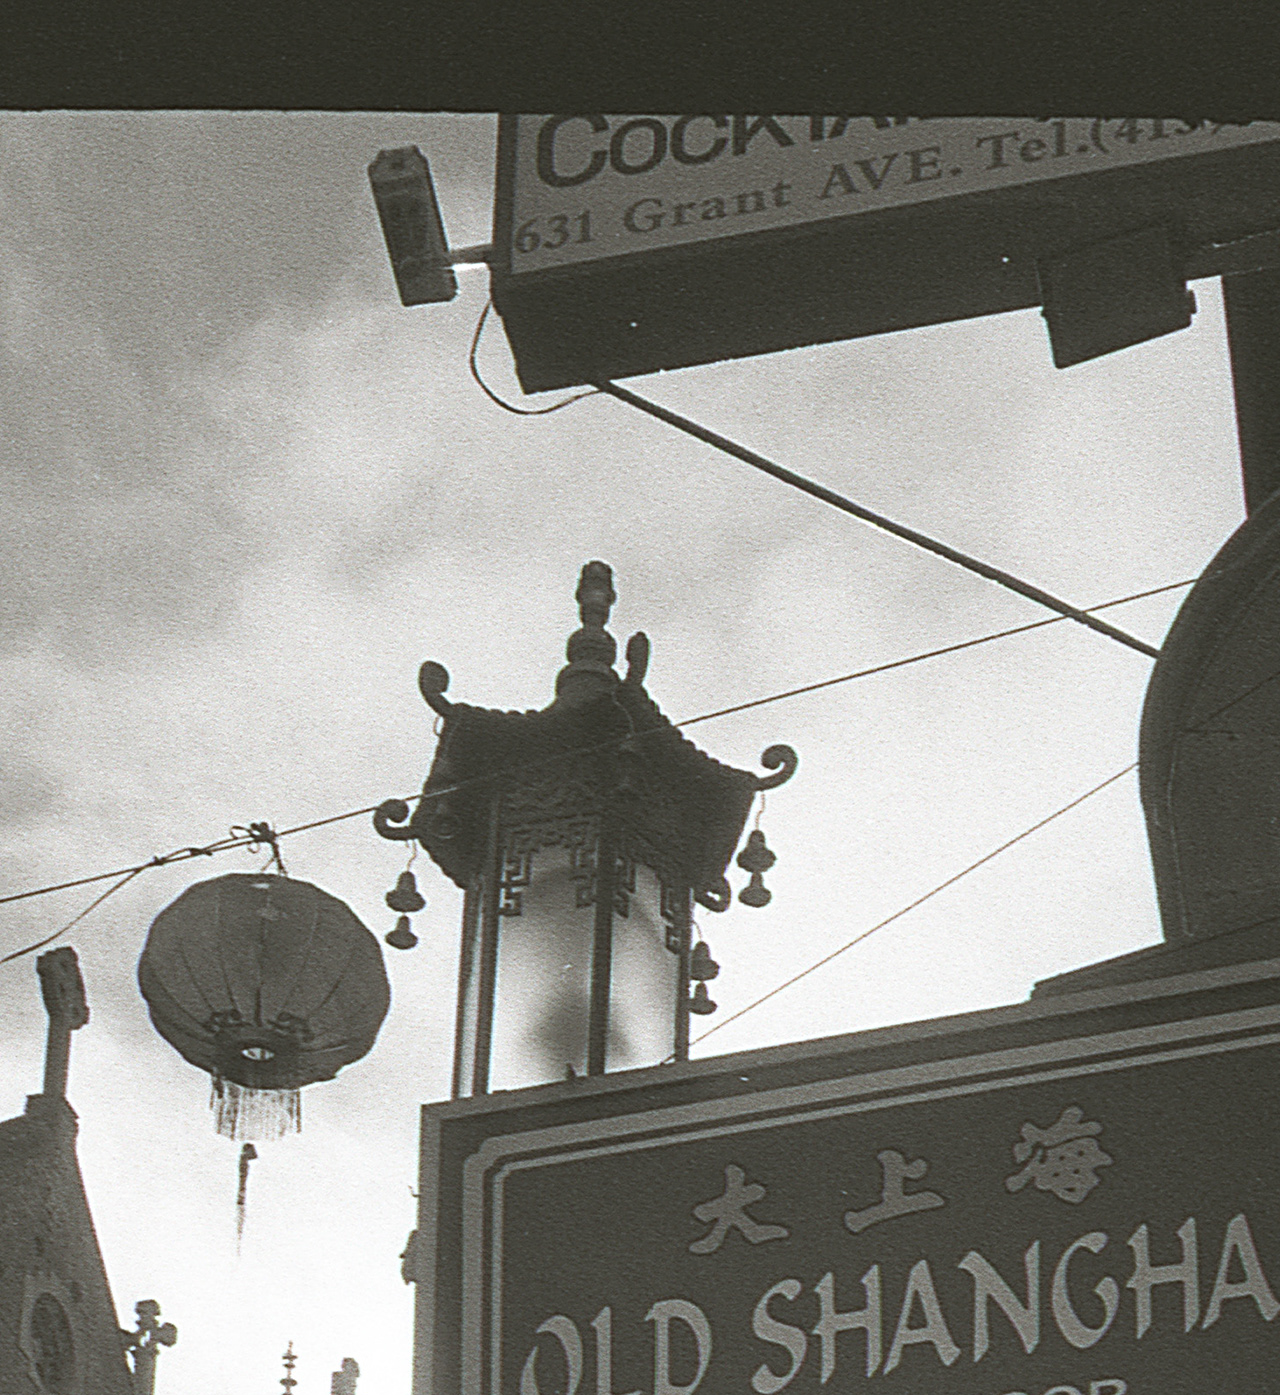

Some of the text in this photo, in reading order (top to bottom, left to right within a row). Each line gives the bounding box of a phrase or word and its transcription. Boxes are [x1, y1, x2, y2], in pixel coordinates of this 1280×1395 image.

[515, 210, 593, 253] 631
[623, 180, 792, 234] Grant
[818, 147, 963, 199] AVE.
